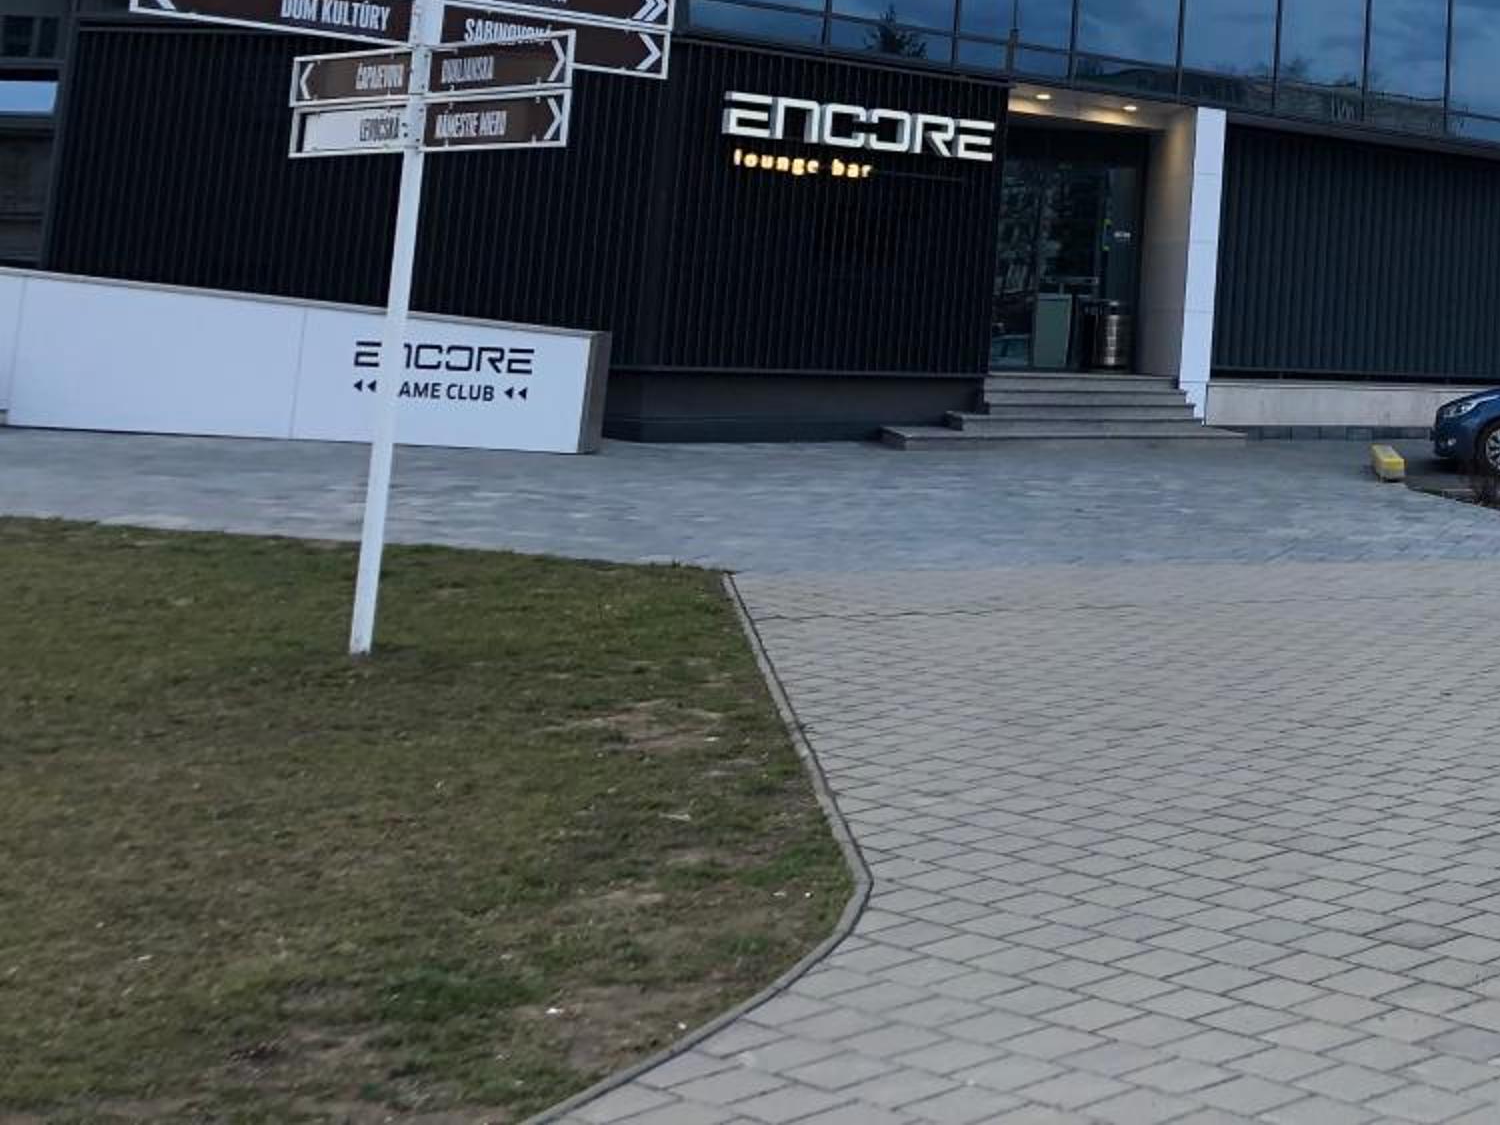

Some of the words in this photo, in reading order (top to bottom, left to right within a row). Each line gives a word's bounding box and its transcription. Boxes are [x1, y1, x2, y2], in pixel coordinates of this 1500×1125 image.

[721, 90, 996, 163] ENCORE
[733, 148, 821, 177] lounge
[830, 158, 874, 179] bar
[397, 381, 442, 401] AME
[446, 382, 495, 402] CLUB
